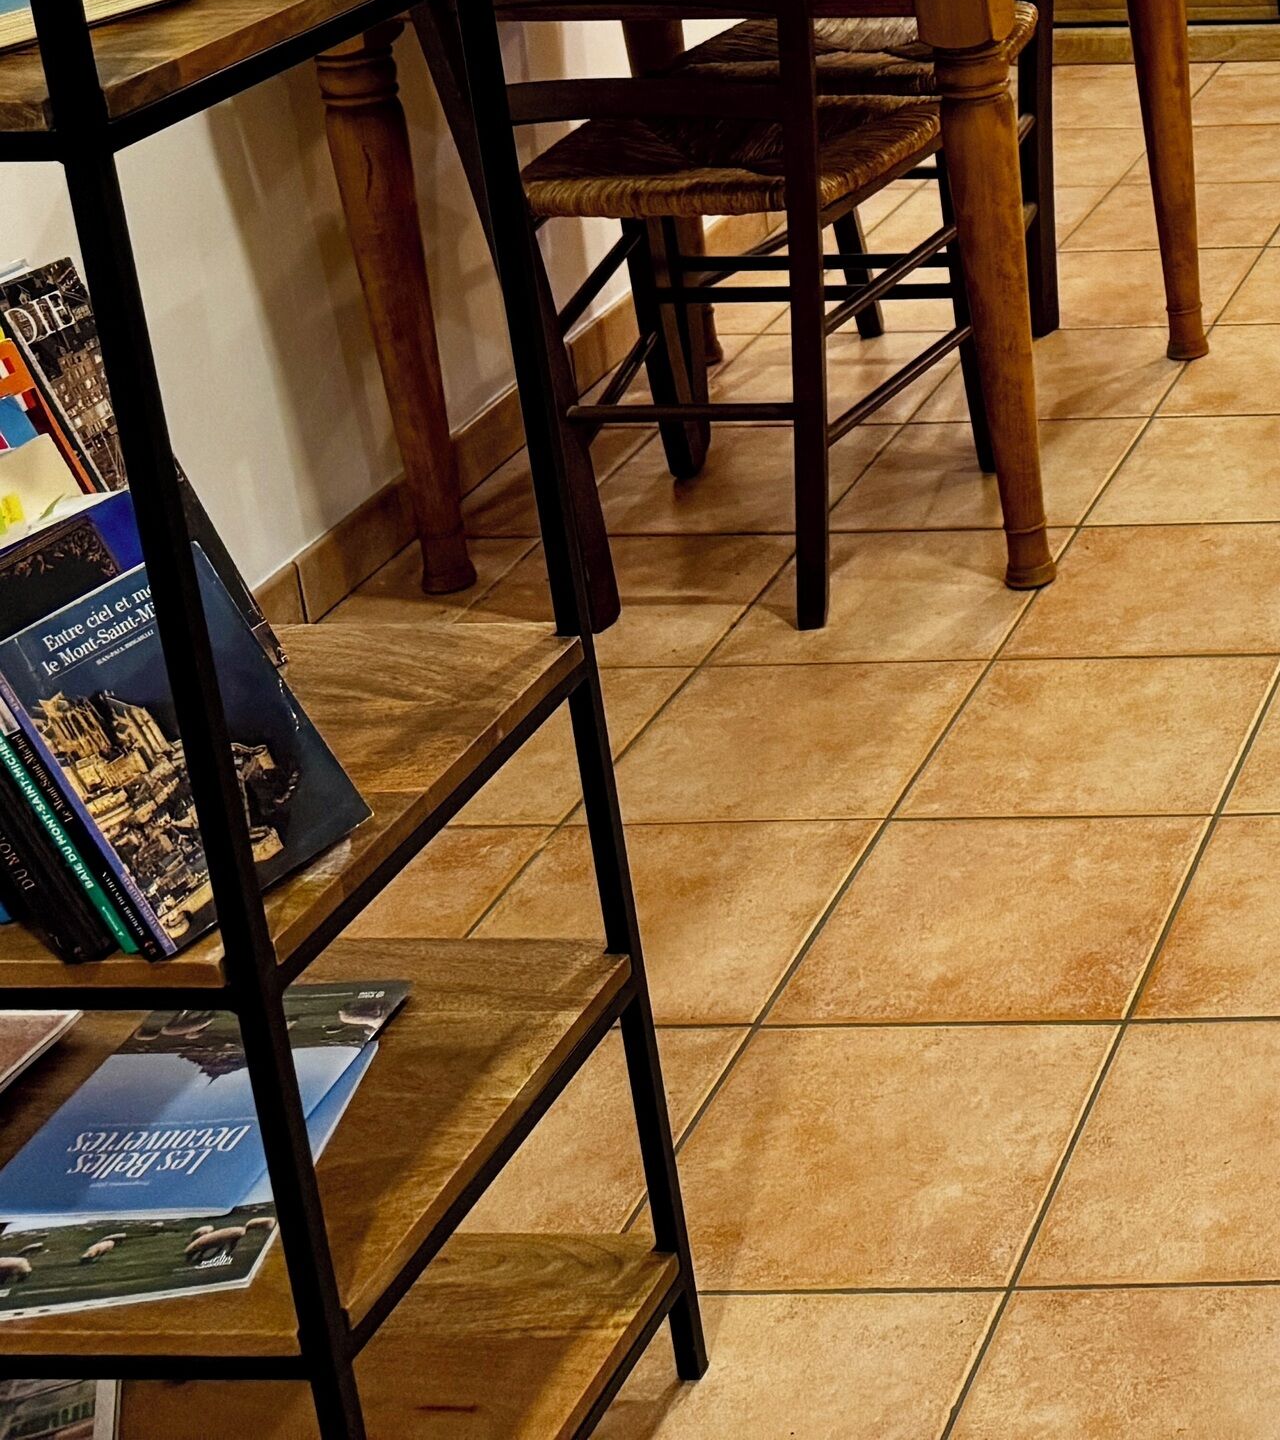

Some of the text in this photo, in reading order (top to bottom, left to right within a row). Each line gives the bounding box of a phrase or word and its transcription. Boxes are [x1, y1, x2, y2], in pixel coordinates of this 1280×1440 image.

[42, 623, 85, 652] Entre
[86, 604, 114, 628] ciel
[114, 596, 132, 612] et
[42, 661, 61, 676] le
[62, 844, 78, 864] DU
[13, 868, 36, 891] DU
[73, 861, 95, 890] BAIE
[66, 1148, 212, 1179] Les Belles
